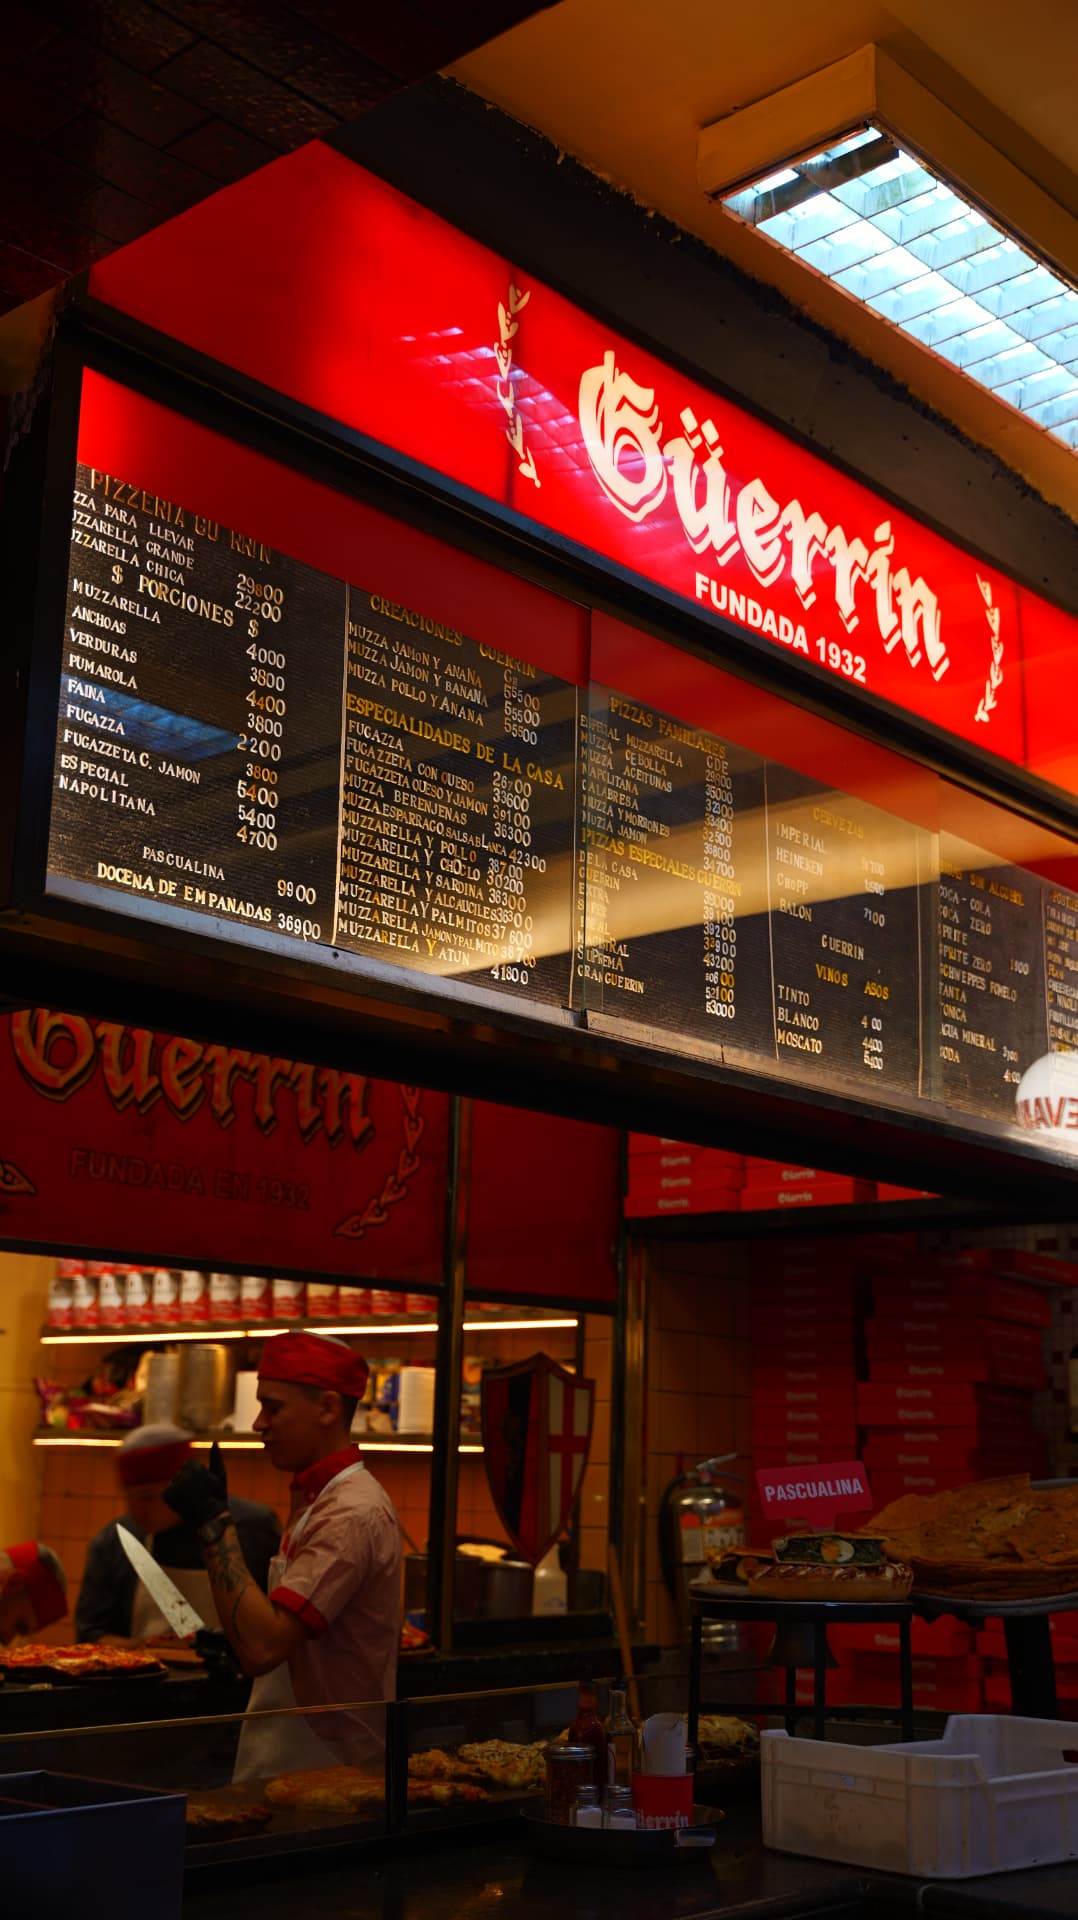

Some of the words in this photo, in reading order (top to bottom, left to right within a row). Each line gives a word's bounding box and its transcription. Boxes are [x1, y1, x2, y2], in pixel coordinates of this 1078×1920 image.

[90, 468, 185, 528] PIZZERIA
[105, 504, 137, 528] PARA
[150, 523, 194, 551] LLEVAR
[111, 565, 123, 584] $
[138, 574, 234, 627] PORCIONES
[146, 541, 194, 569] GRANDE
[236, 574, 284, 605] 29800
[147, 560, 184, 585] CHICA
[235, 591, 281, 622] 22200
[72, 605, 126, 635] ANCHOAS
[250, 667, 285, 691] 3800
[73, 578, 161, 624] MUZZARELLA
[246, 643, 285, 669] 4000
[370, 595, 463, 647] CREACIONES
[695, 571, 809, 654] FUNDADA
[816, 637, 866, 684] 1932
[70, 628, 137, 663] VERDURAS
[246, 689, 286, 716] 4400
[347, 639, 387, 666] MUZZA
[390, 655, 429, 683] JAMON
[434, 673, 442, 687] Y
[445, 681, 488, 708] BANANA
[505, 701, 540, 727] 55500
[348, 622, 389, 649] MUZZA
[433, 657, 440, 669] Y
[444, 664, 482, 688] ANANA
[504, 683, 540, 711] 55500
[67, 678, 106, 703] FAINA
[236, 733, 281, 761] 2200
[69, 654, 137, 689] PUMAROLA
[248, 713, 283, 737] 3800
[348, 661, 386, 688] MUZZA
[391, 678, 426, 702] POLLO
[431, 694, 438, 707] Y
[440, 696, 484, 727] ANANA
[610, 697, 654, 728] PIZZAS
[64, 729, 136, 765] FUGAZZETA
[158, 761, 200, 784] JAMON
[237, 780, 279, 808] 5400
[66, 704, 125, 735] FUGAZZA
[246, 764, 278, 784] 3800
[346, 693, 471, 754] ESPECIALIDADES
[476, 743, 495, 764] DE
[503, 753, 522, 775] LA
[527, 763, 564, 790] CASA
[349, 720, 403, 751] FUGAZZA
[492, 771, 532, 797] 26700
[625, 750, 667, 776] CEBOLLA
[627, 733, 683, 768] MUZZARELLA
[346, 736, 412, 772] FUGAZZETA
[417, 762, 437, 781] CON
[441, 771, 474, 792] QUESO
[493, 788, 529, 812] 33600
[346, 755, 409, 789] FUGAZZETA
[412, 780, 443, 799] QUESO
[493, 805, 530, 830] 39100
[624, 766, 672, 793] ACEITUNAS
[59, 774, 155, 816] NAPOLITANA
[236, 825, 277, 851] 4700
[238, 804, 275, 830] 5400
[342, 808, 421, 846] MUZZARELLA
[426, 836, 433, 849] Y
[441, 841, 476, 862] POLLO
[343, 772, 384, 798] MUZZA
[394, 790, 467, 825] BERENJENAS
[494, 822, 531, 847] 36300
[618, 824, 647, 844] JAMON
[342, 826, 419, 862] MUZZARELLA
[424, 849, 434, 866] Y
[440, 858, 480, 881] CHOCLO
[487, 870, 523, 895] 30200
[508, 848, 546, 872] 42300
[629, 845, 695, 881] ESPECIALES
[776, 822, 826, 855] IMPERIAL
[776, 847, 823, 876] HEINEKEN
[143, 846, 225, 880] PASCUALINA
[277, 880, 316, 904] 9900
[341, 845, 420, 881] MUZZARELLA
[426, 872, 433, 884] Y
[436, 876, 483, 901] SARDINA
[341, 863, 416, 898] MUZZARELLA
[97, 862, 154, 891] DOCENA
[159, 879, 176, 896] DE
[184, 886, 272, 922] EMPANADAS
[278, 913, 320, 941] 36900
[338, 900, 418, 935] MUZZARELLA
[340, 881, 418, 917] MUZZARELLA
[432, 907, 491, 936] PALMITOS
[779, 898, 812, 922] BALON
[970, 917, 992, 935] ZERO
[338, 918, 419, 952] MUZZARELLA
[426, 939, 437, 956] Y
[438, 947, 470, 965] ATUN
[491, 965, 528, 984] 41800
[704, 922, 736, 943] 39200
[821, 934, 864, 960] GUERRIN
[939, 924, 968, 946] PRITE
[604, 972, 644, 993] GUERRIN
[778, 985, 810, 1006] TINTO
[816, 964, 848, 987] VINOS
[776, 1029, 822, 1054] MOSCATO
[778, 1006, 819, 1031] BLANCO
[68, 1149, 206, 1196] FUNDADA
[214, 1170, 249, 1199] EN
[764, 1478, 864, 1502] PASCUALINA
